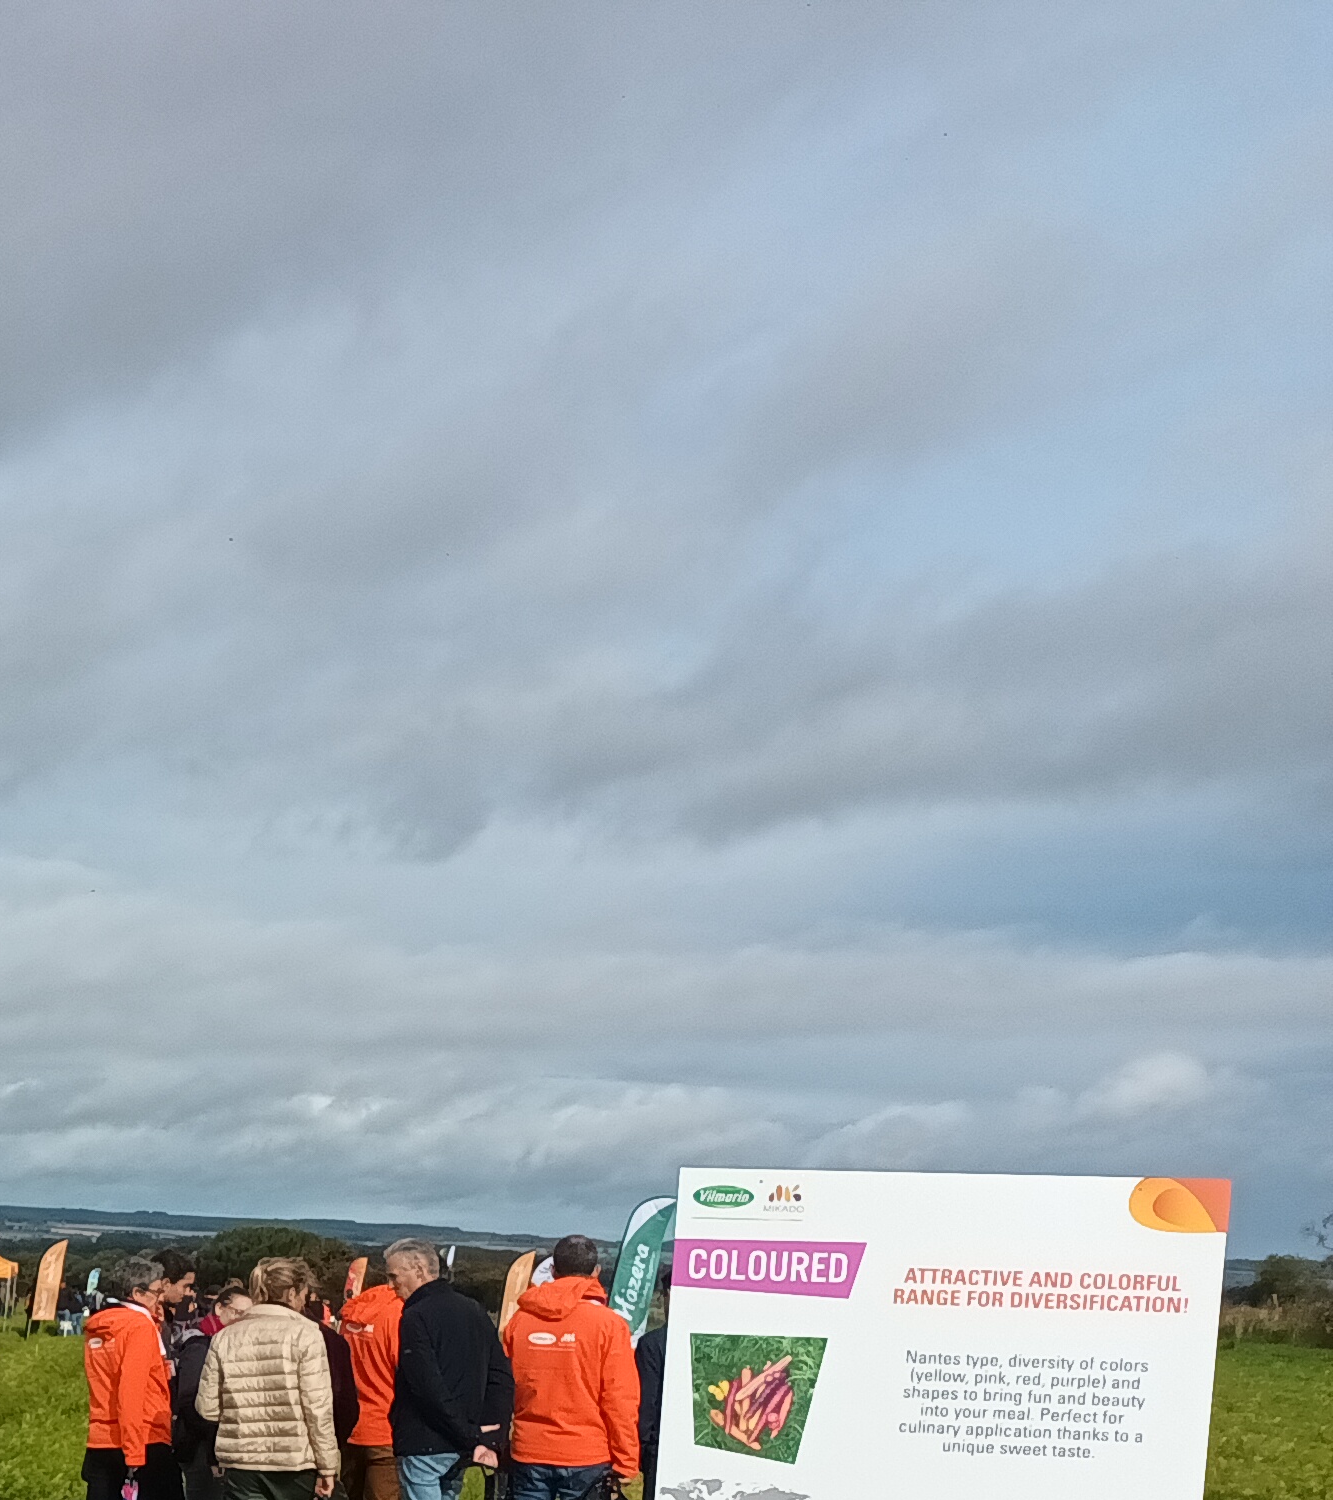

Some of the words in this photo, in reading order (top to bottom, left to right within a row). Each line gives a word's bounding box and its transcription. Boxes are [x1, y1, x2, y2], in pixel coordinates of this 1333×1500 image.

[699, 1190, 749, 1203] Vilmorin
[763, 1205, 804, 1213] MIKADO
[689, 1249, 848, 1283] COLOURED
[613, 1243, 650, 1321] Hazera
[904, 1268, 1023, 1287] ATTRACTIVE
[1029, 1272, 1072, 1289] AND
[1080, 1273, 1181, 1292] COLORFUL
[893, 1289, 960, 1306] RANGE
[967, 1291, 1003, 1307] FOR
[1010, 1292, 1189, 1313] DIVERSIFICATION!
[906, 1350, 960, 1365] Nantes
[966, 1354, 1002, 1369] type,
[1008, 1354, 1074, 1372] diversity
[1080, 1357, 1095, 1370] of
[1100, 1358, 1149, 1373] colors
[910, 1367, 969, 1385] (yellow,
[974, 1371, 1010, 1386] pink,
[1016, 1373, 1045, 1387] red,
[1051, 1375, 1106, 1389] purple)
[1112, 1377, 1140, 1390] and
[903, 1386, 958, 1402] shapes
[964, 1389, 977, 1401] to
[983, 1388, 1023, 1406] bring
[1028, 1390, 1051, 1404] fun
[1057, 1392, 1086, 1405] and
[1091, 1393, 1145, 1410] beauty
[920, 1403, 949, 1417] into
[954, 1406, 988, 1421] your
[993, 1407, 1035, 1421] meal.
[1040, 1407, 1098, 1424] Perfect
[1103, 1411, 1124, 1425] for
[899, 1421, 961, 1437] culinary
[965, 1423, 1051, 1440] application
[1057, 1426, 1109, 1442] thanks
[1114, 1429, 1129, 1442] to
[1134, 1433, 1143, 1443] a
[943, 1440, 994, 1456] unique
[1000, 1444, 1047, 1457] sweet
[1052, 1445, 1095, 1459] taste.
